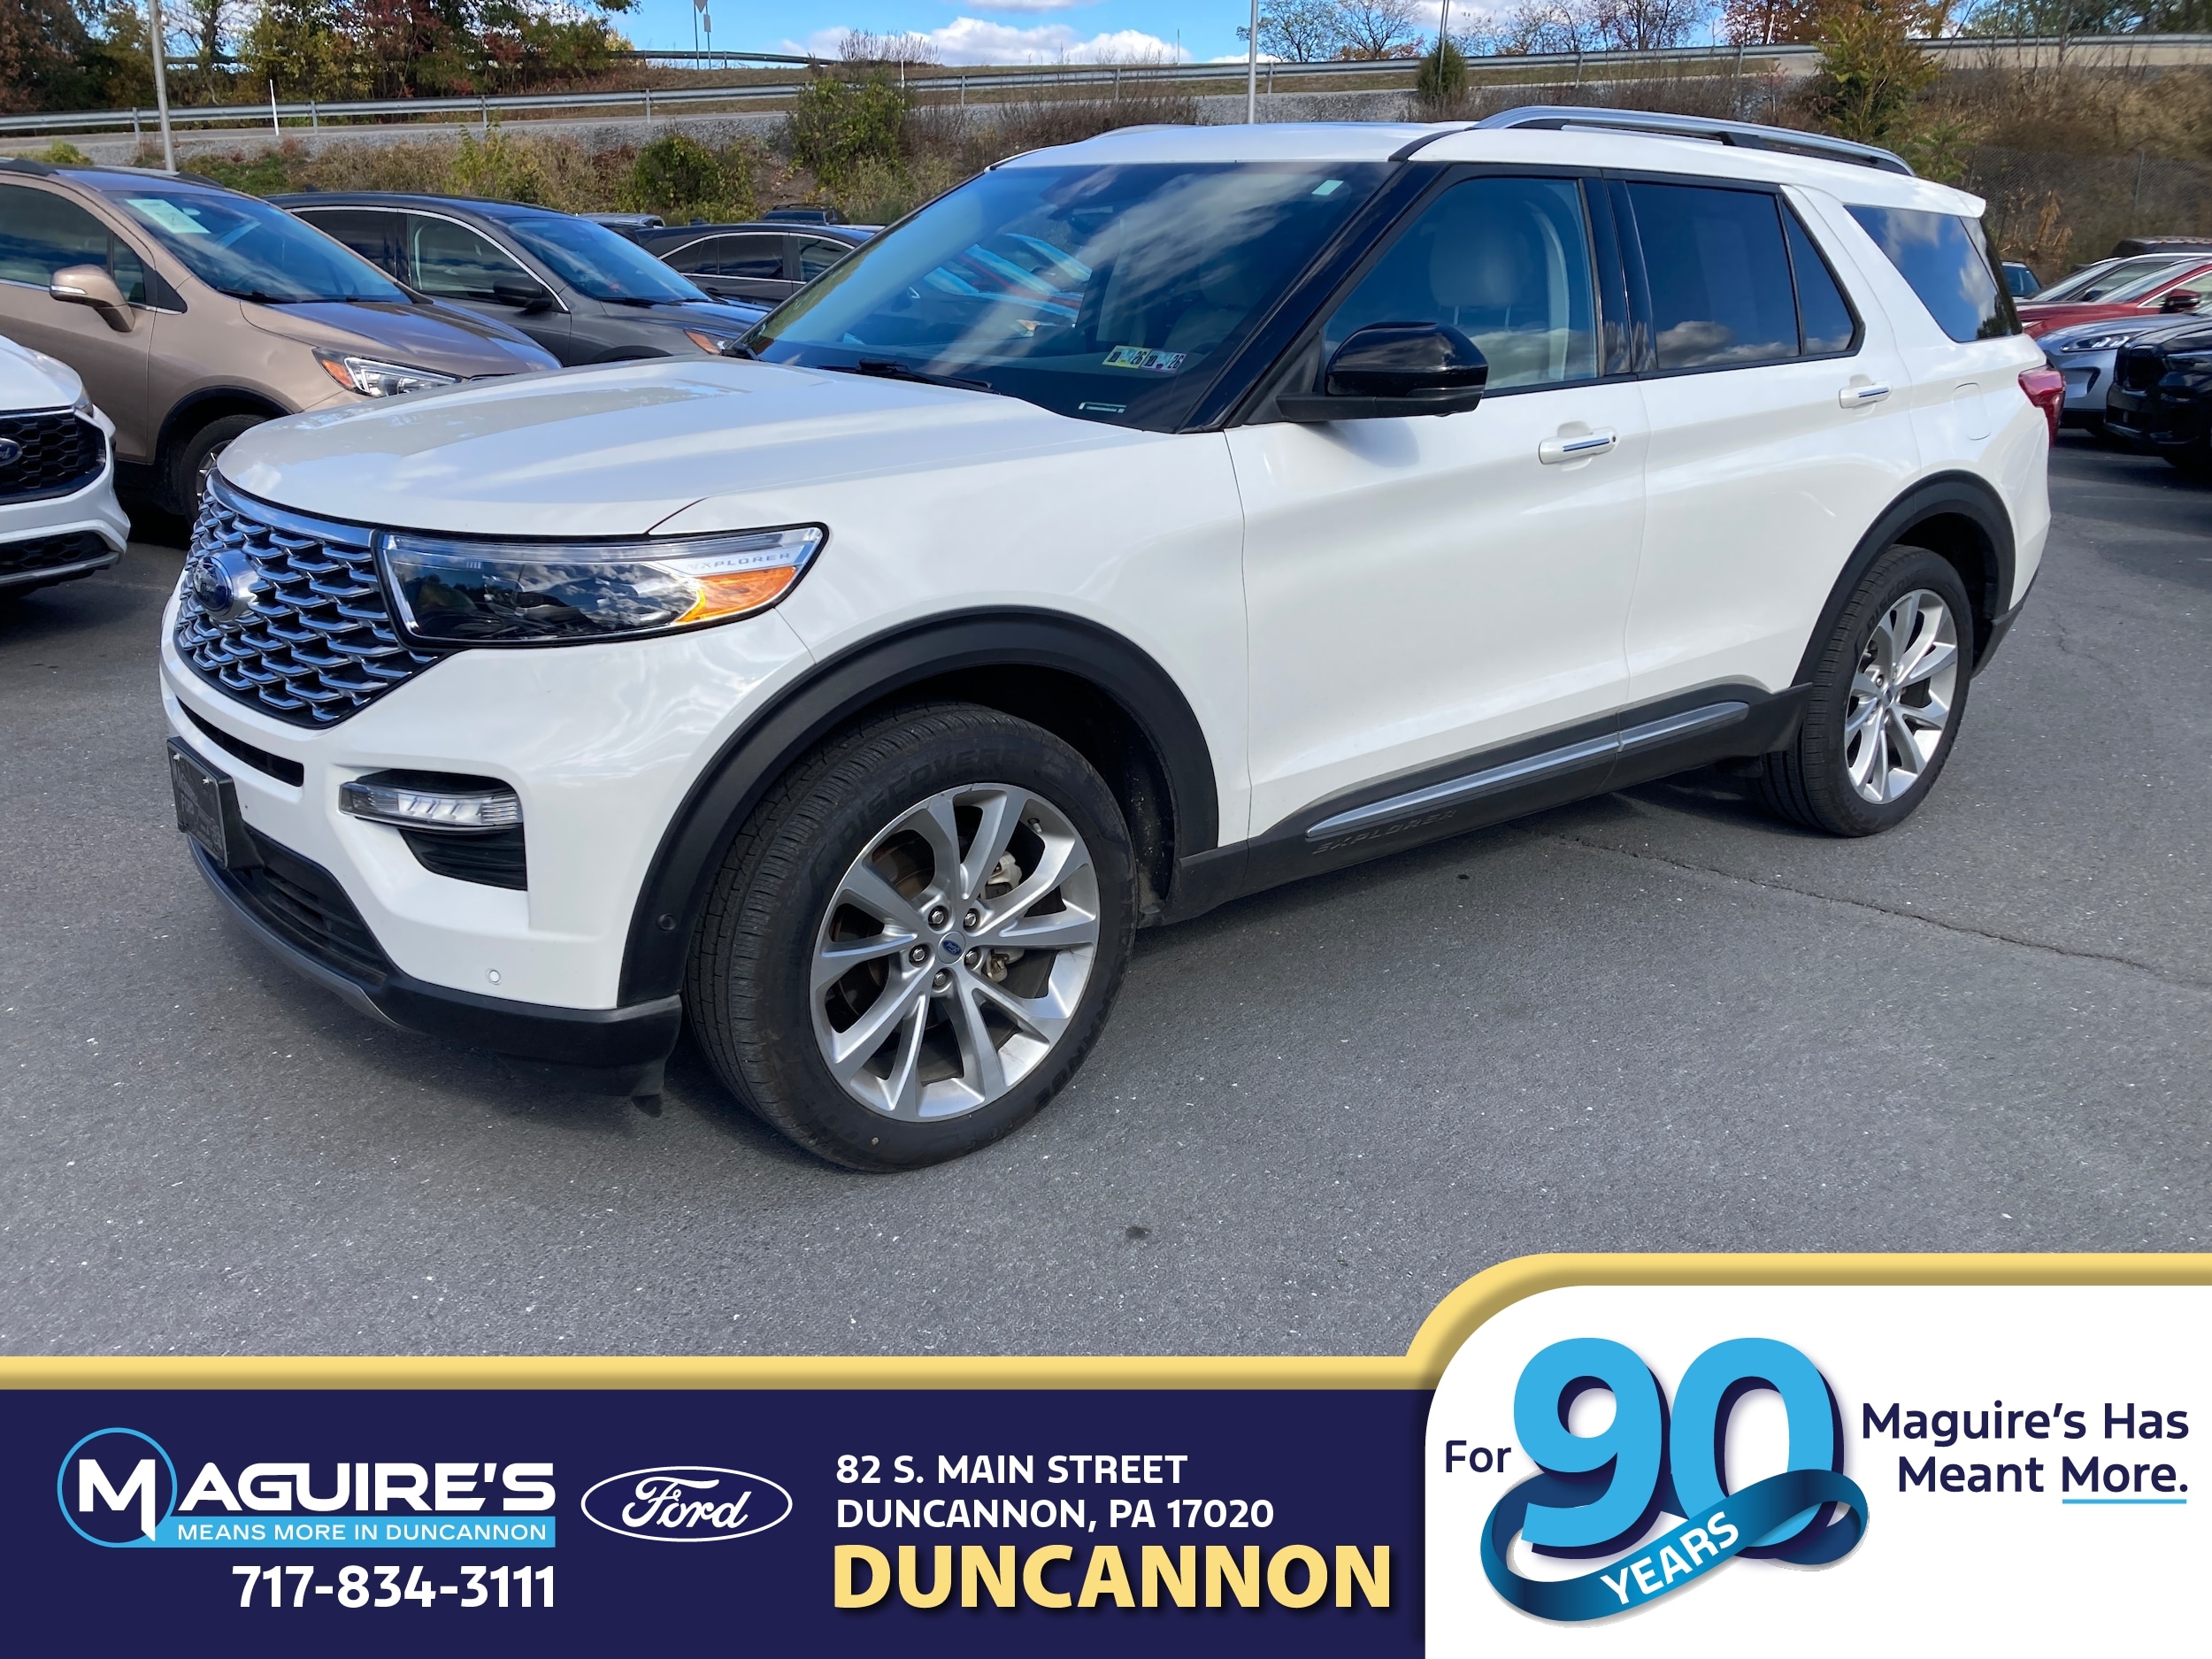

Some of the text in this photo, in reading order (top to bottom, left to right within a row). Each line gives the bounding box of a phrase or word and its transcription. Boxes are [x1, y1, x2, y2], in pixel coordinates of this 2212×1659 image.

[1130, 350, 1147, 365] 26
[1168, 354, 1184, 369] 26
[1312, 810, 1457, 855] EXPLORER
